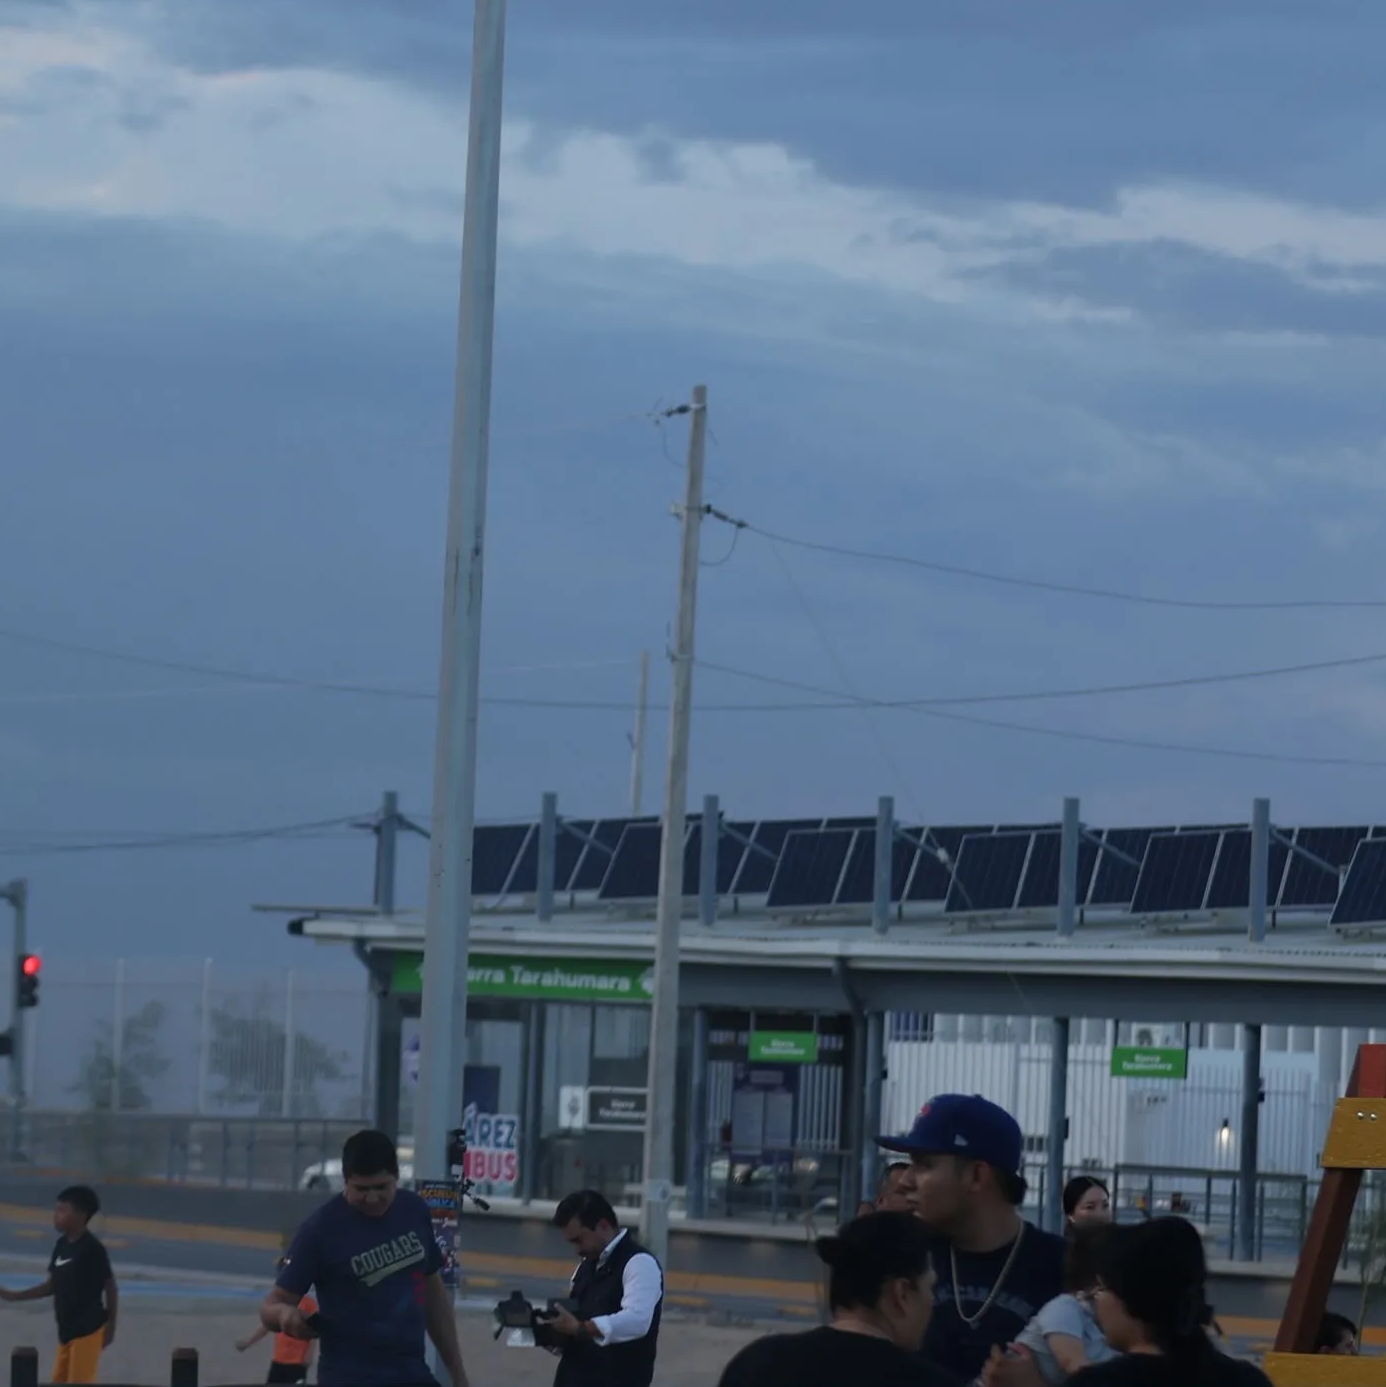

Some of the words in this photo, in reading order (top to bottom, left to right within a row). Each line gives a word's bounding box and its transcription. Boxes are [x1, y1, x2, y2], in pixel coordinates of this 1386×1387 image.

[466, 966, 505, 984] erra
[510, 965, 631, 992] Tarahumara
[465, 1103, 517, 1149] ÁREZ
[351, 1231, 422, 1276] COUGARS
